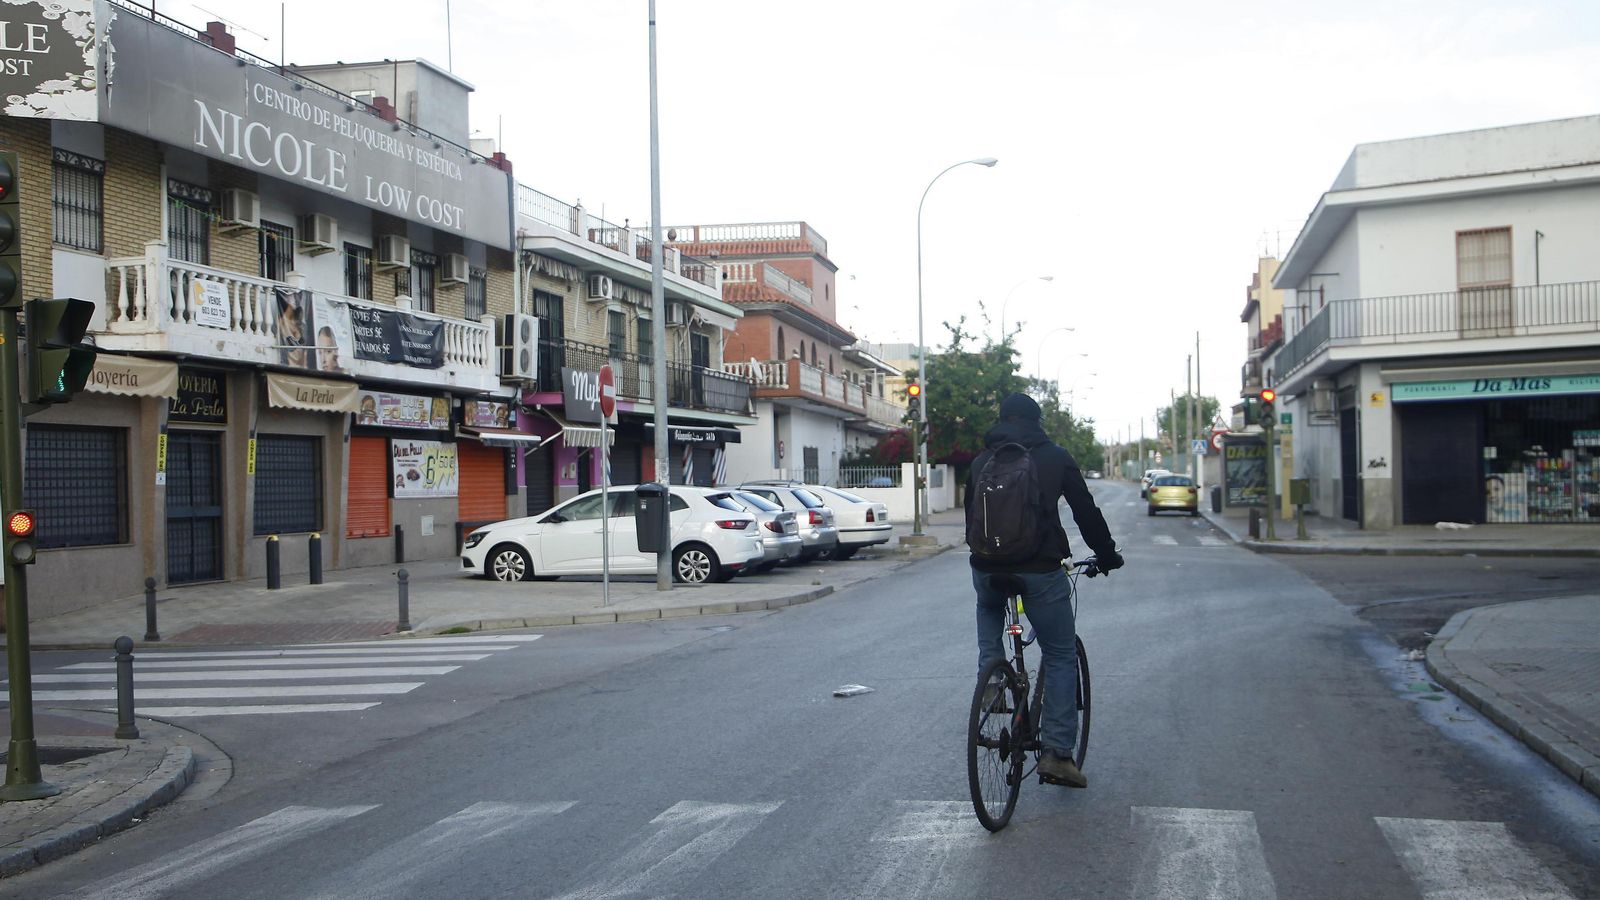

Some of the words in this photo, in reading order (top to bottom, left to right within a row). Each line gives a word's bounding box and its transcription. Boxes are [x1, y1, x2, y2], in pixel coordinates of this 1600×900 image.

[253, 83, 311, 121] CENTRO
[313, 105, 331, 129] DE
[405, 144, 414, 161] Y
[193, 99, 349, 192] NICOLE
[365, 175, 411, 213] LOW
[416, 195, 463, 230] COST
[207, 295, 222, 306] VENDE
[1472, 377, 1502, 393] Da
[1508, 376, 1552, 391] Mas
[296, 387, 308, 402] La
[310, 388, 335, 404] Perla
[191, 397, 224, 416] Perla
